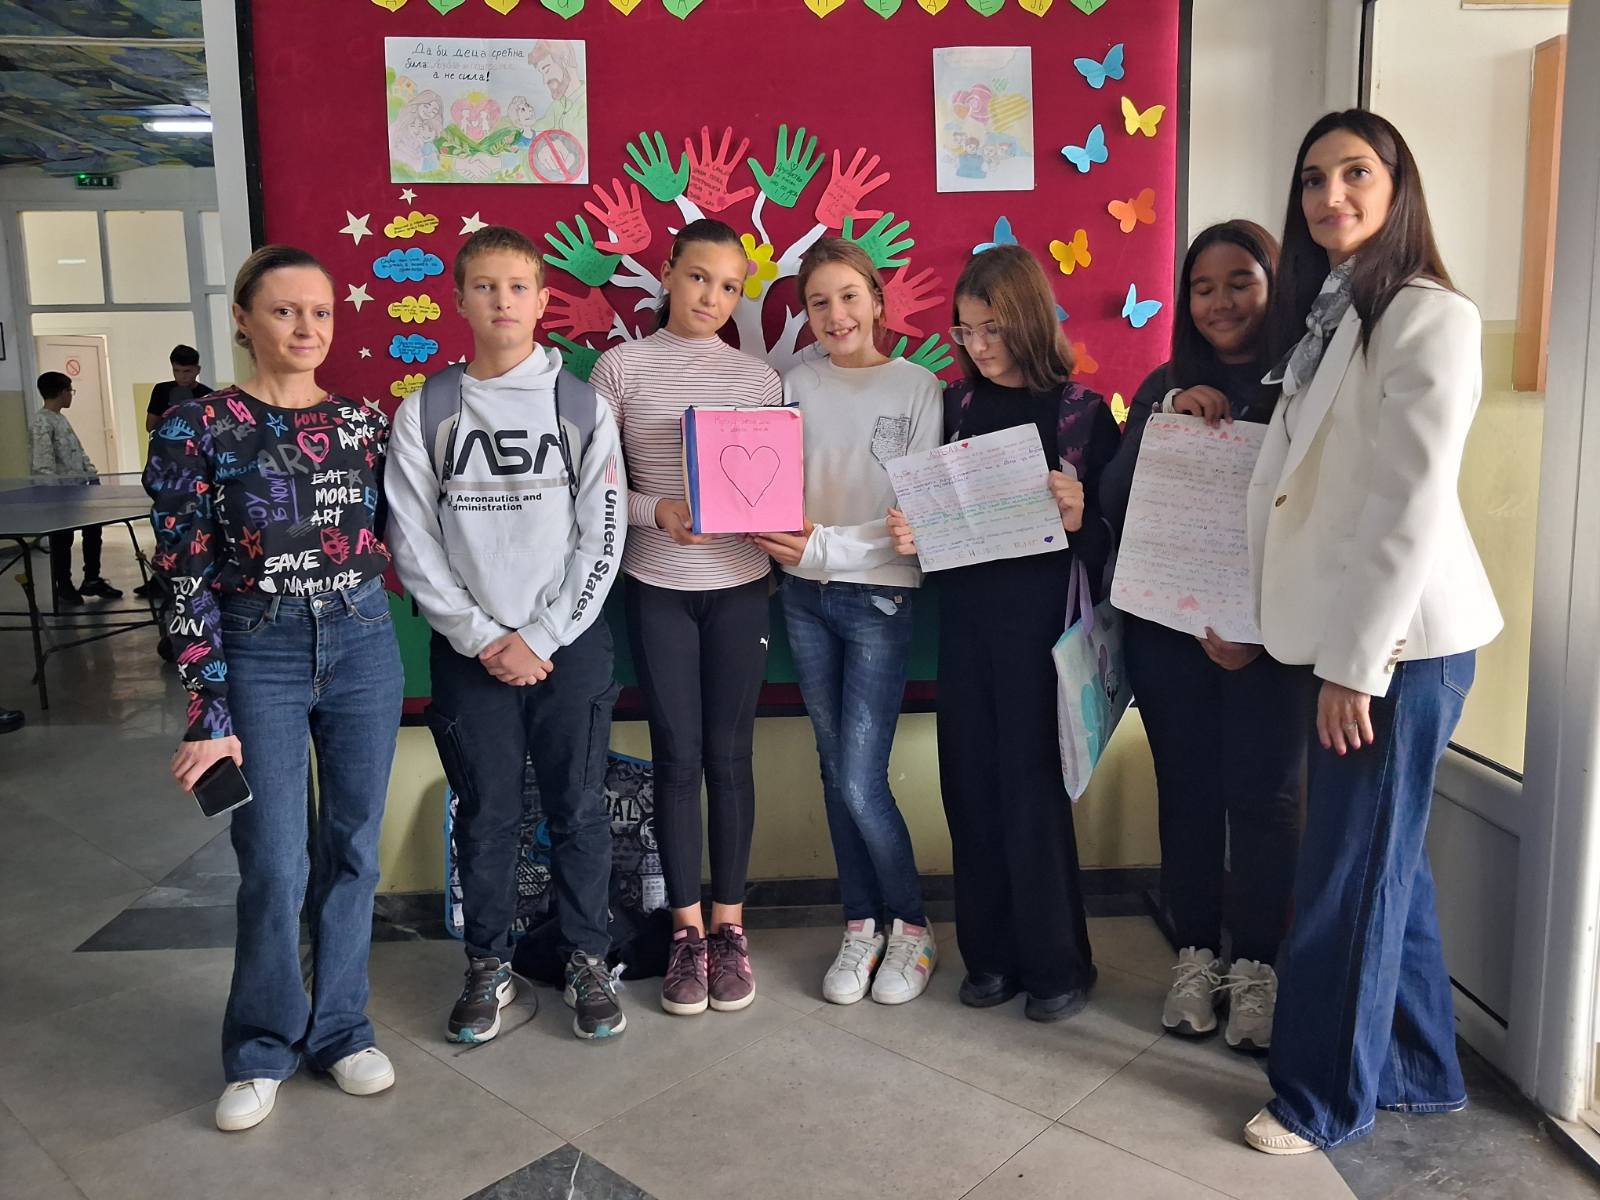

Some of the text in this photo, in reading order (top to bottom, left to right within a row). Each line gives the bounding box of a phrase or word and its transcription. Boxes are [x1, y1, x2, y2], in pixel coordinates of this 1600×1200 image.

[412, 42, 432, 56] Да
[436, 45, 448, 57] би
[294, 411, 328, 428] LOVE
[453, 430, 568, 475] ASA
[310, 469, 348, 485] EAT
[315, 486, 363, 507] MORE
[456, 494, 520, 503] Aeronautics
[523, 493, 542, 501] and
[310, 505, 344, 527] ART
[604, 490, 618, 557] United
[264, 549, 321, 574] SAVE
[283, 568, 363, 597] NATURE
[571, 560, 610, 622] States
